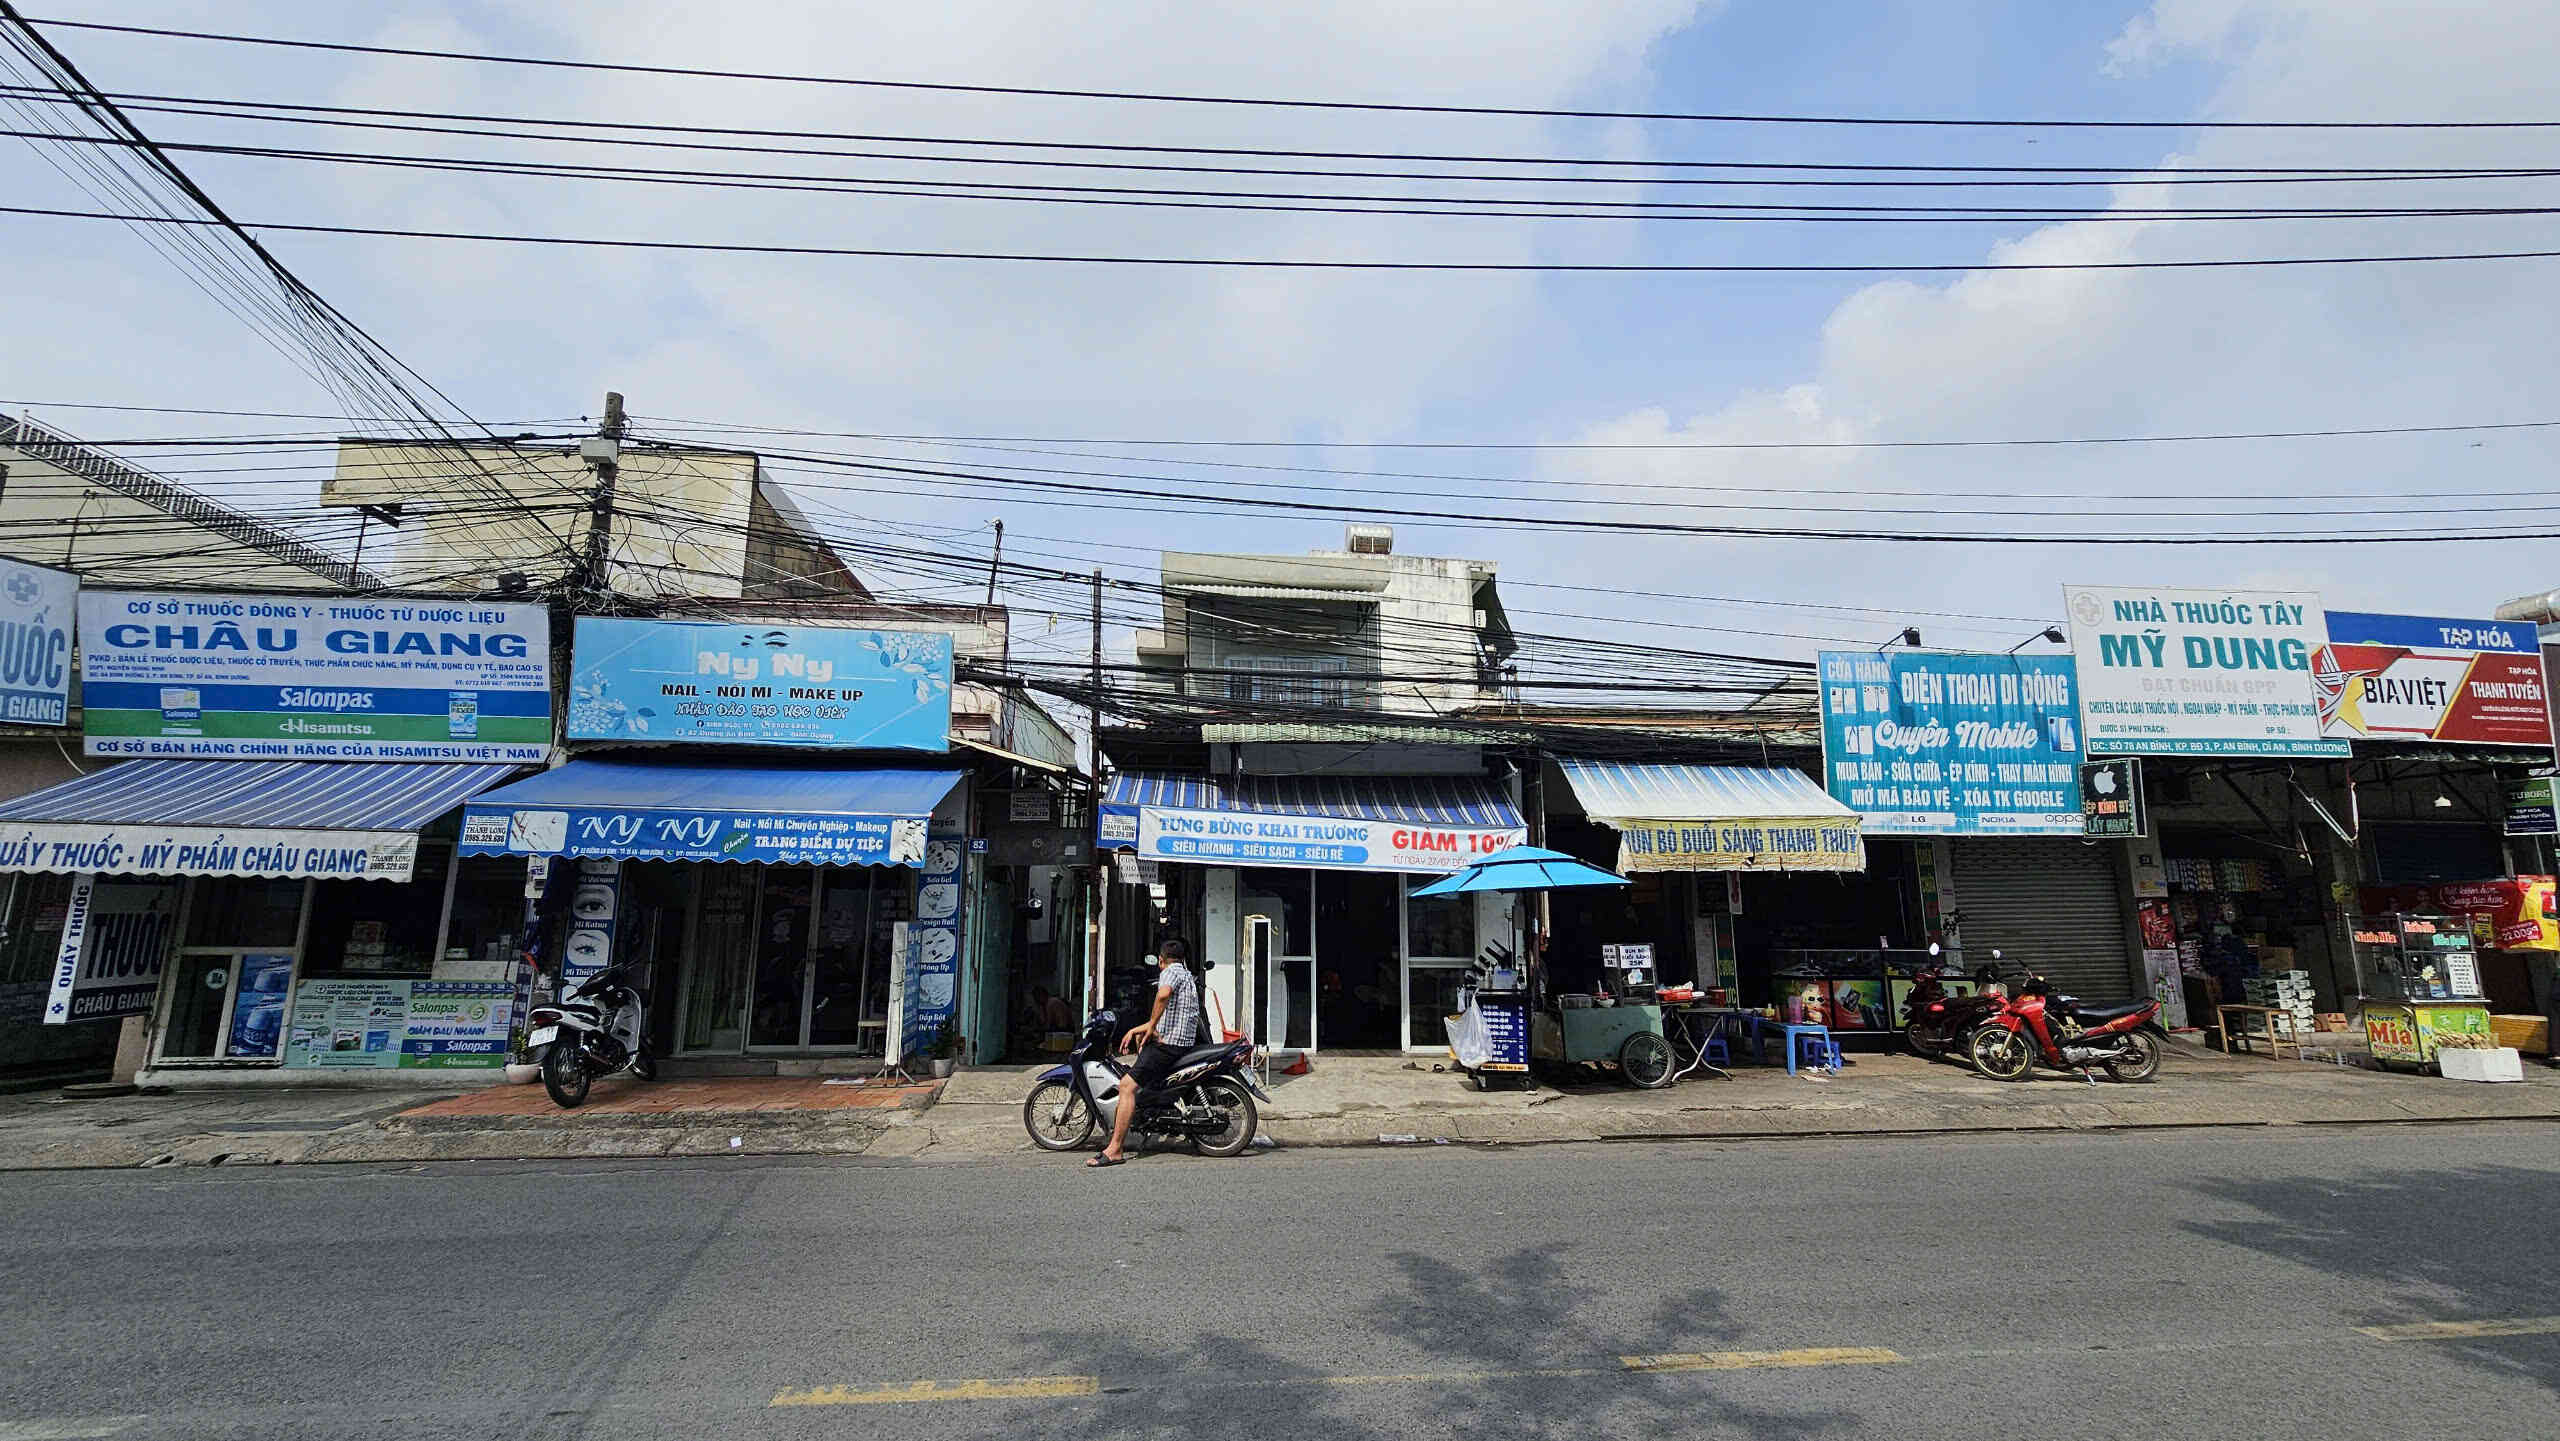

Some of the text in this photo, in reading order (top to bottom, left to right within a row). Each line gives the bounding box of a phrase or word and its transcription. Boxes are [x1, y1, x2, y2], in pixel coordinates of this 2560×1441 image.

[128, 600, 152, 615] CƠ
[186, 600, 244, 617] THUỐC
[250, 603, 297, 618] ĐÔNG
[302, 607, 313, 618] Y
[329, 604, 385, 620] THUỐC
[2113, 596, 2304, 626] NHÀ THUỐC TÂY
[105, 621, 527, 658] CHÂU GIANG
[2477, 626, 2515, 648] HÓA
[2099, 628, 2308, 670] MỸ DUNG
[698, 651, 833, 683] Ny Ny
[1828, 656, 1890, 681] CỬA HÀNG
[278, 686, 373, 711] Salonpas
[662, 684, 700, 697] NAIL
[752, 686, 772, 698] MI
[790, 687, 836, 701] MAKE
[842, 690, 864, 701] UP
[1901, 666, 2069, 713] ĐIỆN THOẠI DI ĐỘNG
[2470, 682, 2507, 699] THANH
[8, 694, 64, 724] GIANG
[1954, 721, 2039, 751] Mobile
[96, 740, 119, 753] CƠ
[151, 740, 186, 754] BÁN
[191, 740, 235, 755] HÀNG
[240, 741, 289, 755] CHÍNH
[342, 743, 374, 757] CỦA
[379, 746, 461, 758] HISAMITSU
[467, 745, 502, 760] VIỆT
[507, 748, 541, 759] NAM
[1836, 761, 1859, 781] MUA
[1860, 758, 1883, 782] BÁN
[1891, 757, 1914, 782] SỬA
[1915, 759, 1942, 782] CHỮA
[1964, 759, 1990, 783] KÍNH
[1998, 762, 2021, 783] THAY
[2022, 760, 2047, 783] MÀN
[2048, 761, 2073, 783] HÌNH
[1877, 786, 1901, 807] MÃ
[1903, 784, 1931, 807] BẢO
[1933, 786, 1951, 810] VỆ
[1963, 785, 1992, 807] XÓA
[1995, 789, 2012, 808] TK
[2013, 789, 2065, 808] GOOGLE
[733, 818, 751, 829] Nail
[855, 822, 888, 834] Makeup
[1911, 816, 2016, 824] LG NOKIA
[754, 836, 798, 849] TRANG
[1258, 823, 1299, 839] KHAI
[1303, 824, 1369, 842] TRƯƠNG
[1656, 823, 1678, 854] BÒ
[1722, 823, 1764, 854] SÁNG
[1767, 827, 1817, 854] THANH
[51, 833, 124, 869] THUỐC
[140, 837, 175, 869] MỸ
[176, 833, 239, 871] PHẨM
[242, 842, 300, 873] CHÂU
[304, 848, 368, 874] GIANG
[972, 840, 985, 850] 82
[1173, 839, 1197, 852] SIÊU
[1199, 842, 1234, 856] NHANH
[1243, 843, 1266, 857] SIÊU
[1269, 845, 1296, 860] SẠCH
[1304, 845, 1328, 860] SIÊU
[68, 885, 90, 940] THUỐC
[74, 993, 114, 1015] CHÂU
[410, 1002, 460, 1015] Salonpas
[446, 1040, 493, 1053] Salonpas
